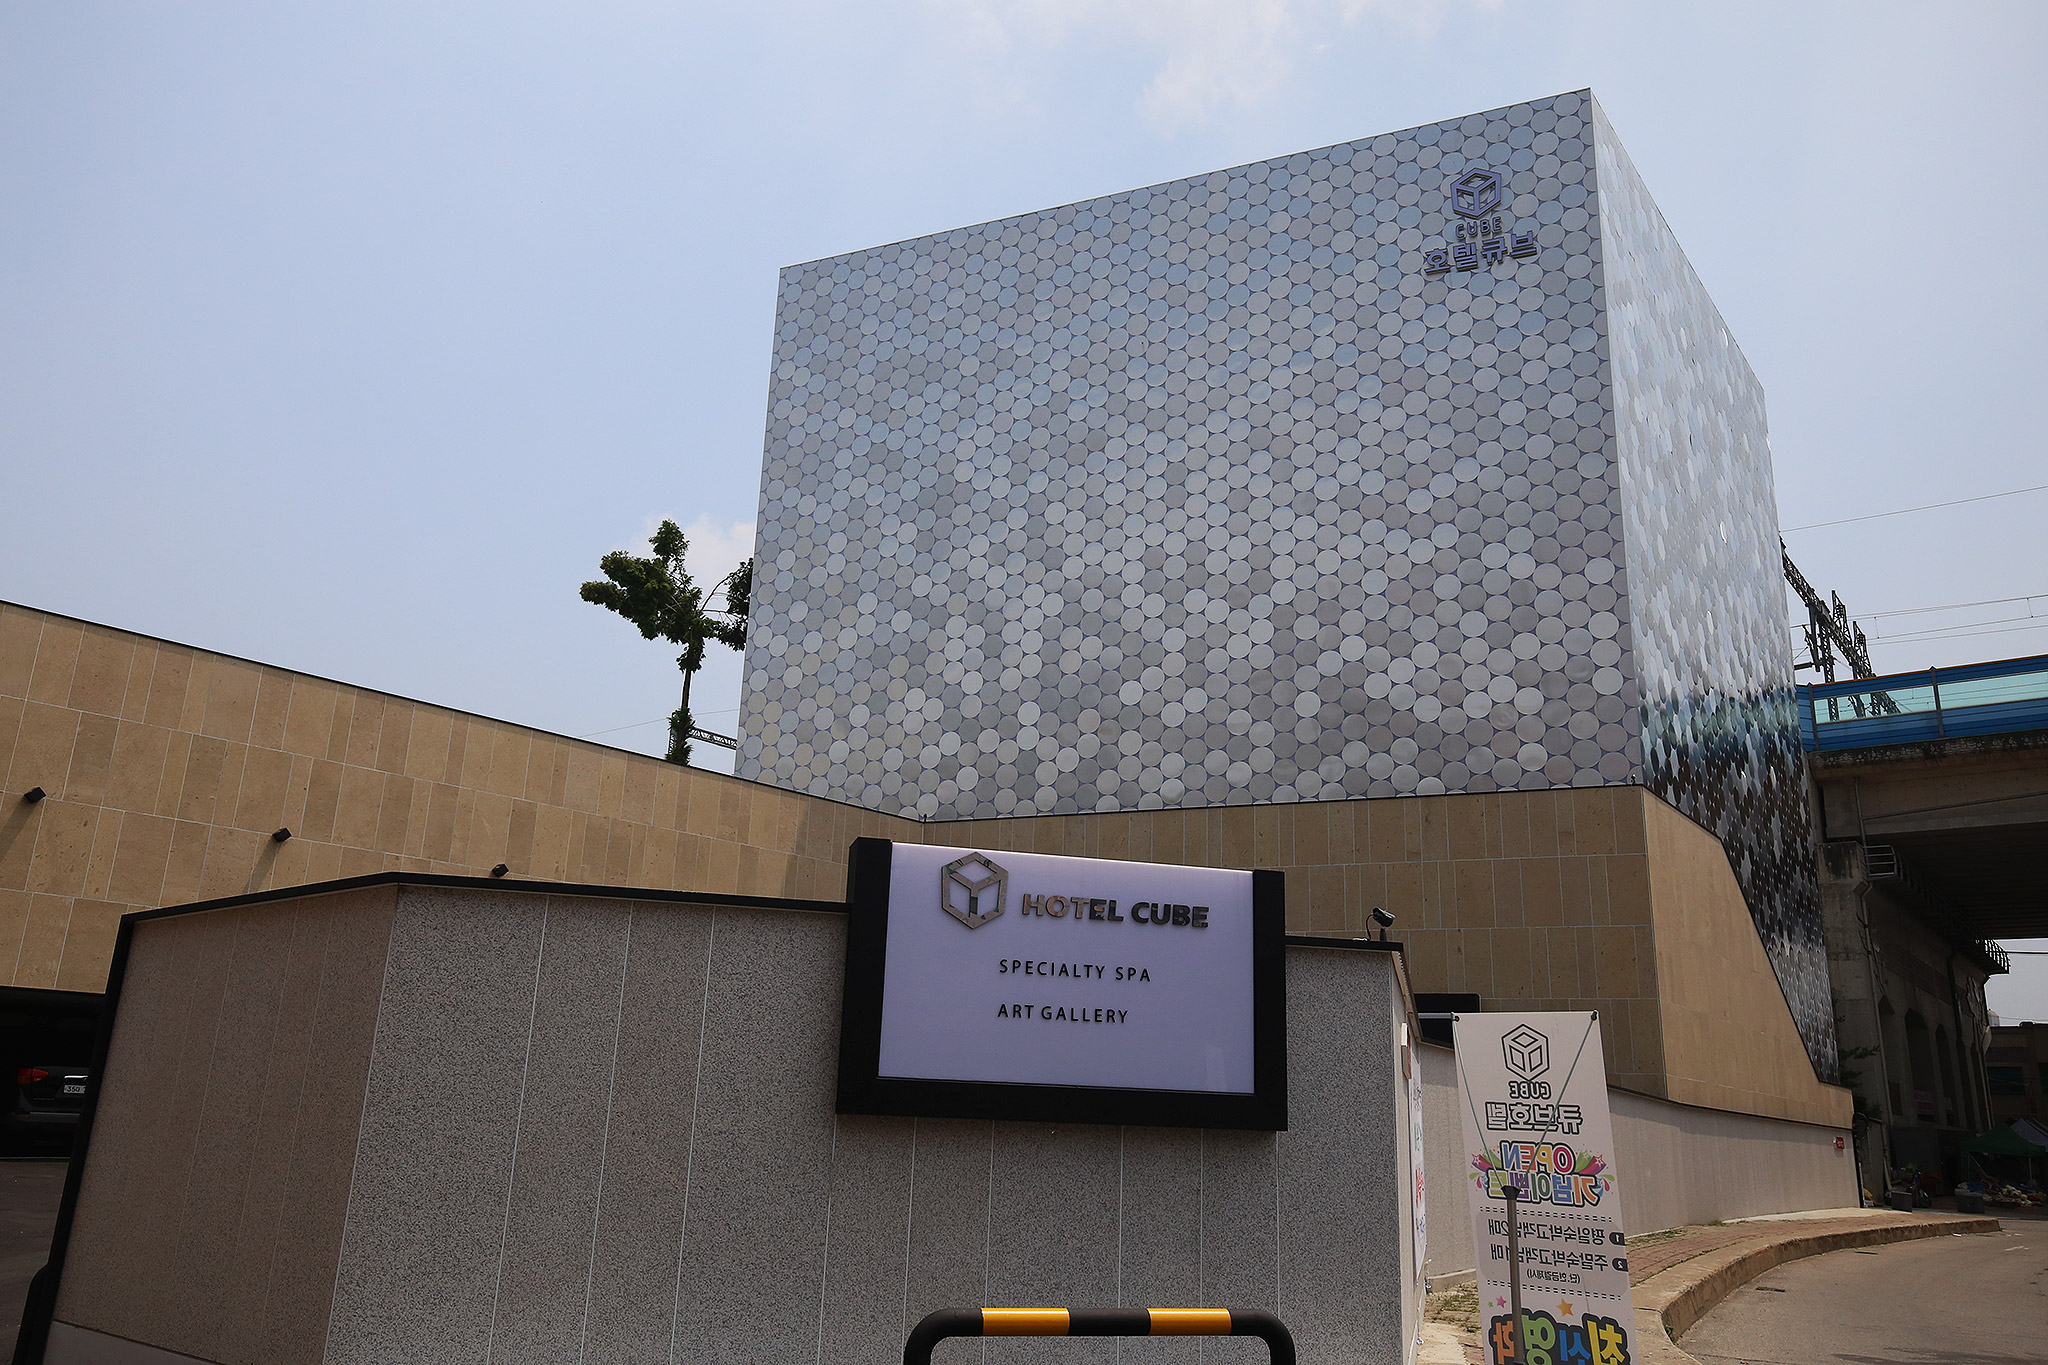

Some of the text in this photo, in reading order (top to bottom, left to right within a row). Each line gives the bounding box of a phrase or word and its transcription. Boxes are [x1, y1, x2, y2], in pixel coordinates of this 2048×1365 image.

[1455, 217, 1503, 240] CUBE
[1424, 230, 1538, 275] 호텔큐브
[1021, 893, 1210, 928] HOTEL CUBE
[999, 959, 1151, 982] SPECIALTY SPA
[997, 1003, 1129, 1024] ART GALLERY
